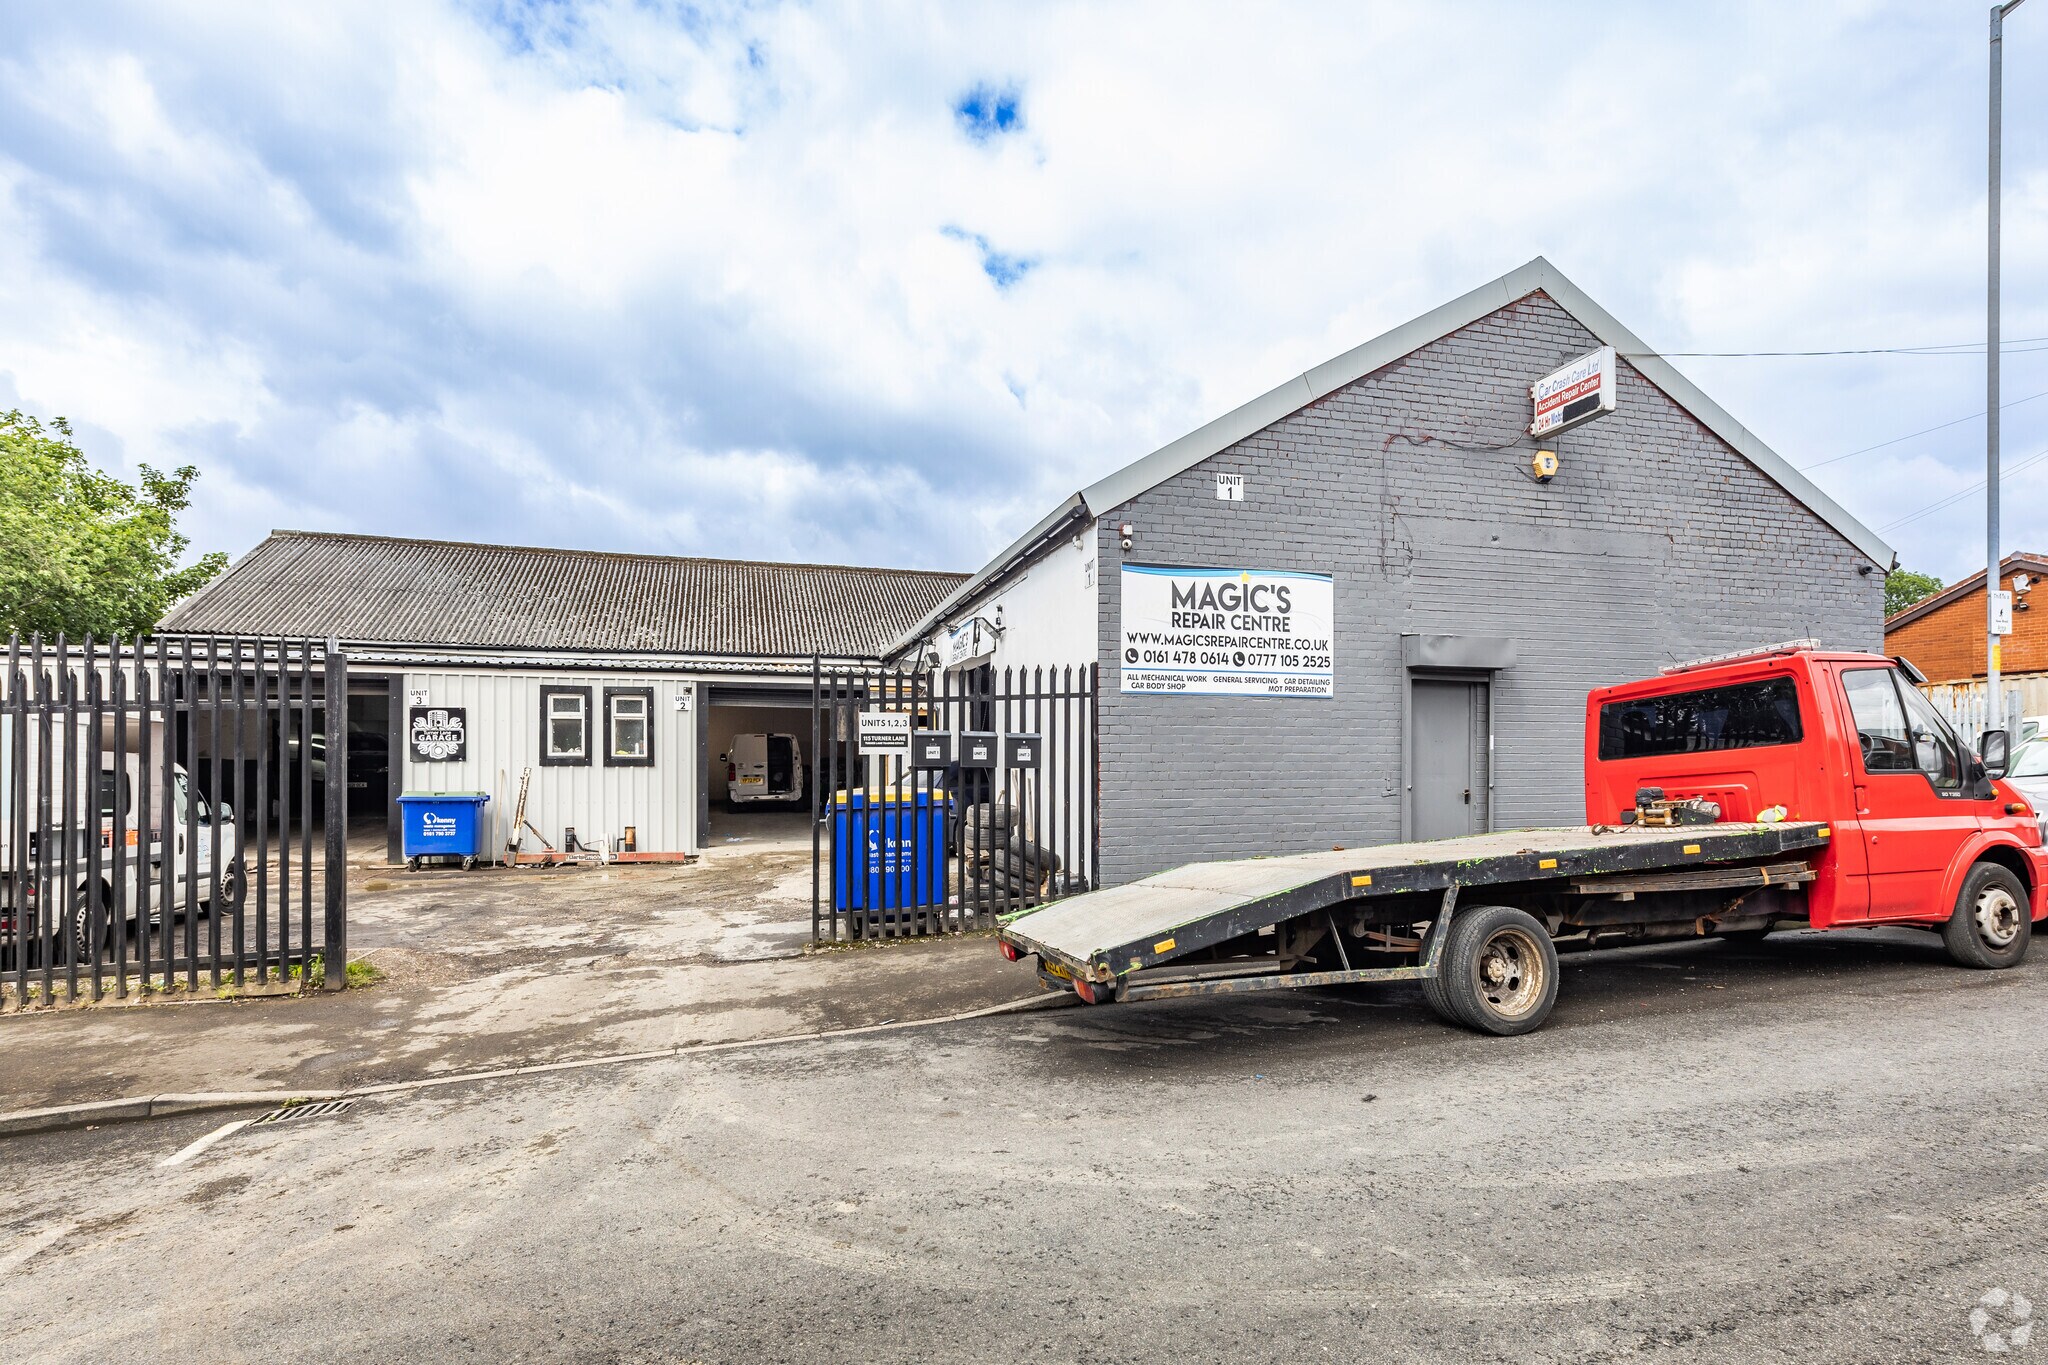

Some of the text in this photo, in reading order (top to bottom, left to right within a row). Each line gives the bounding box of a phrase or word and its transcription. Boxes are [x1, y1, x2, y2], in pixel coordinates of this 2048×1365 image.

[1538, 359, 1600, 401] Car Crash Care Ltd
[1537, 376, 1600, 412] Accident Repair Center
[1218, 475, 1242, 486] UNIT
[1227, 486, 1233, 500] 1
[1171, 580, 1292, 614] MAGIC'S
[1171, 612, 1291, 633] REPAIR CENTRE
[1126, 632, 1329, 652] WWW.MAGICSREPAIRCENTRE.CO.UK
[1143, 649, 1331, 669] 0161 478 0614 0777 105 2525
[1126, 673, 1208, 684] ALL MECHANICAL WORK
[1212, 675, 1279, 686] GENERAL SERVICING
[1283, 677, 1331, 686] CAR DETAILING
[1130, 681, 1187, 691] CAR BODY SHOP
[1267, 685, 1327, 694] MOT PREPARATION
[415, 696, 423, 705] 3
[680, 702, 686, 710] 2
[861, 719, 908, 728] UNITS 1,2,3
